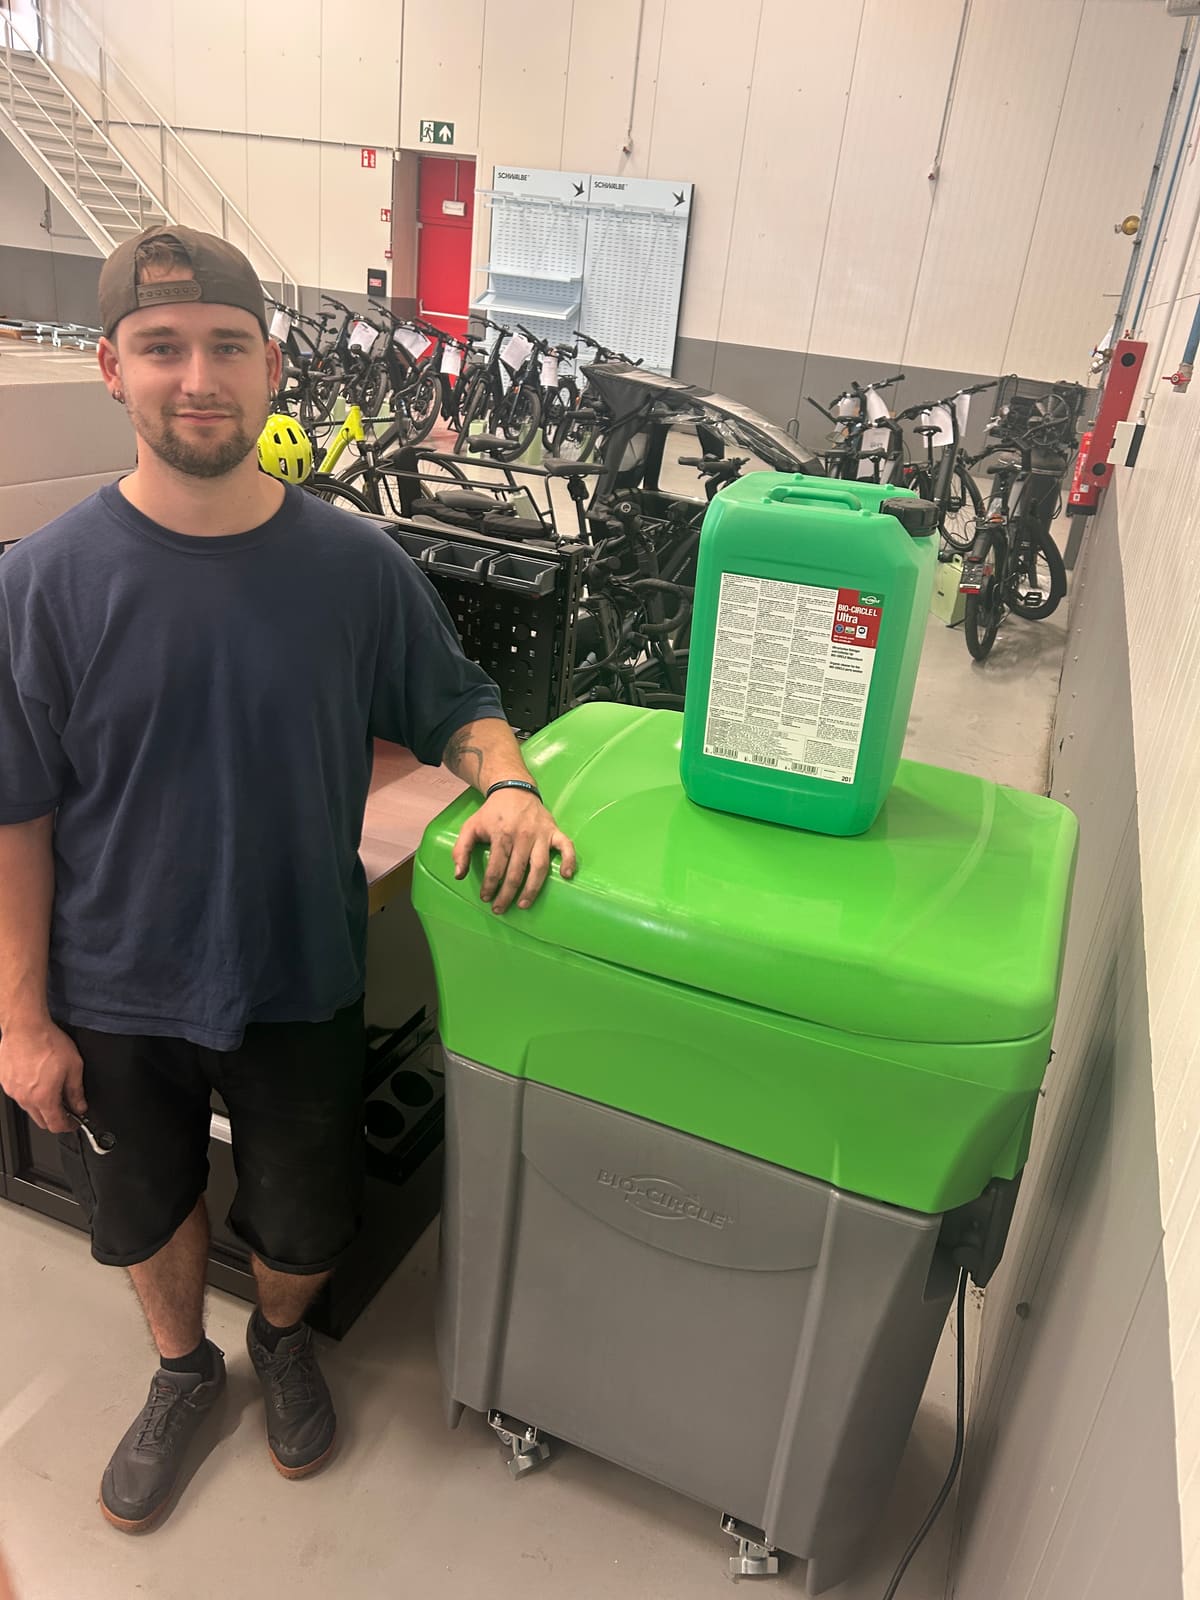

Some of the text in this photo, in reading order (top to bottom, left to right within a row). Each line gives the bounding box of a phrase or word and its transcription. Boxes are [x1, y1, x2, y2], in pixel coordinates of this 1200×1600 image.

[497, 172, 528, 181] SCHWALBE
[594, 181, 626, 190] SCHWALBE
[837, 604, 873, 616] BIO-CIRCLE
[836, 612, 858, 623] Ultra
